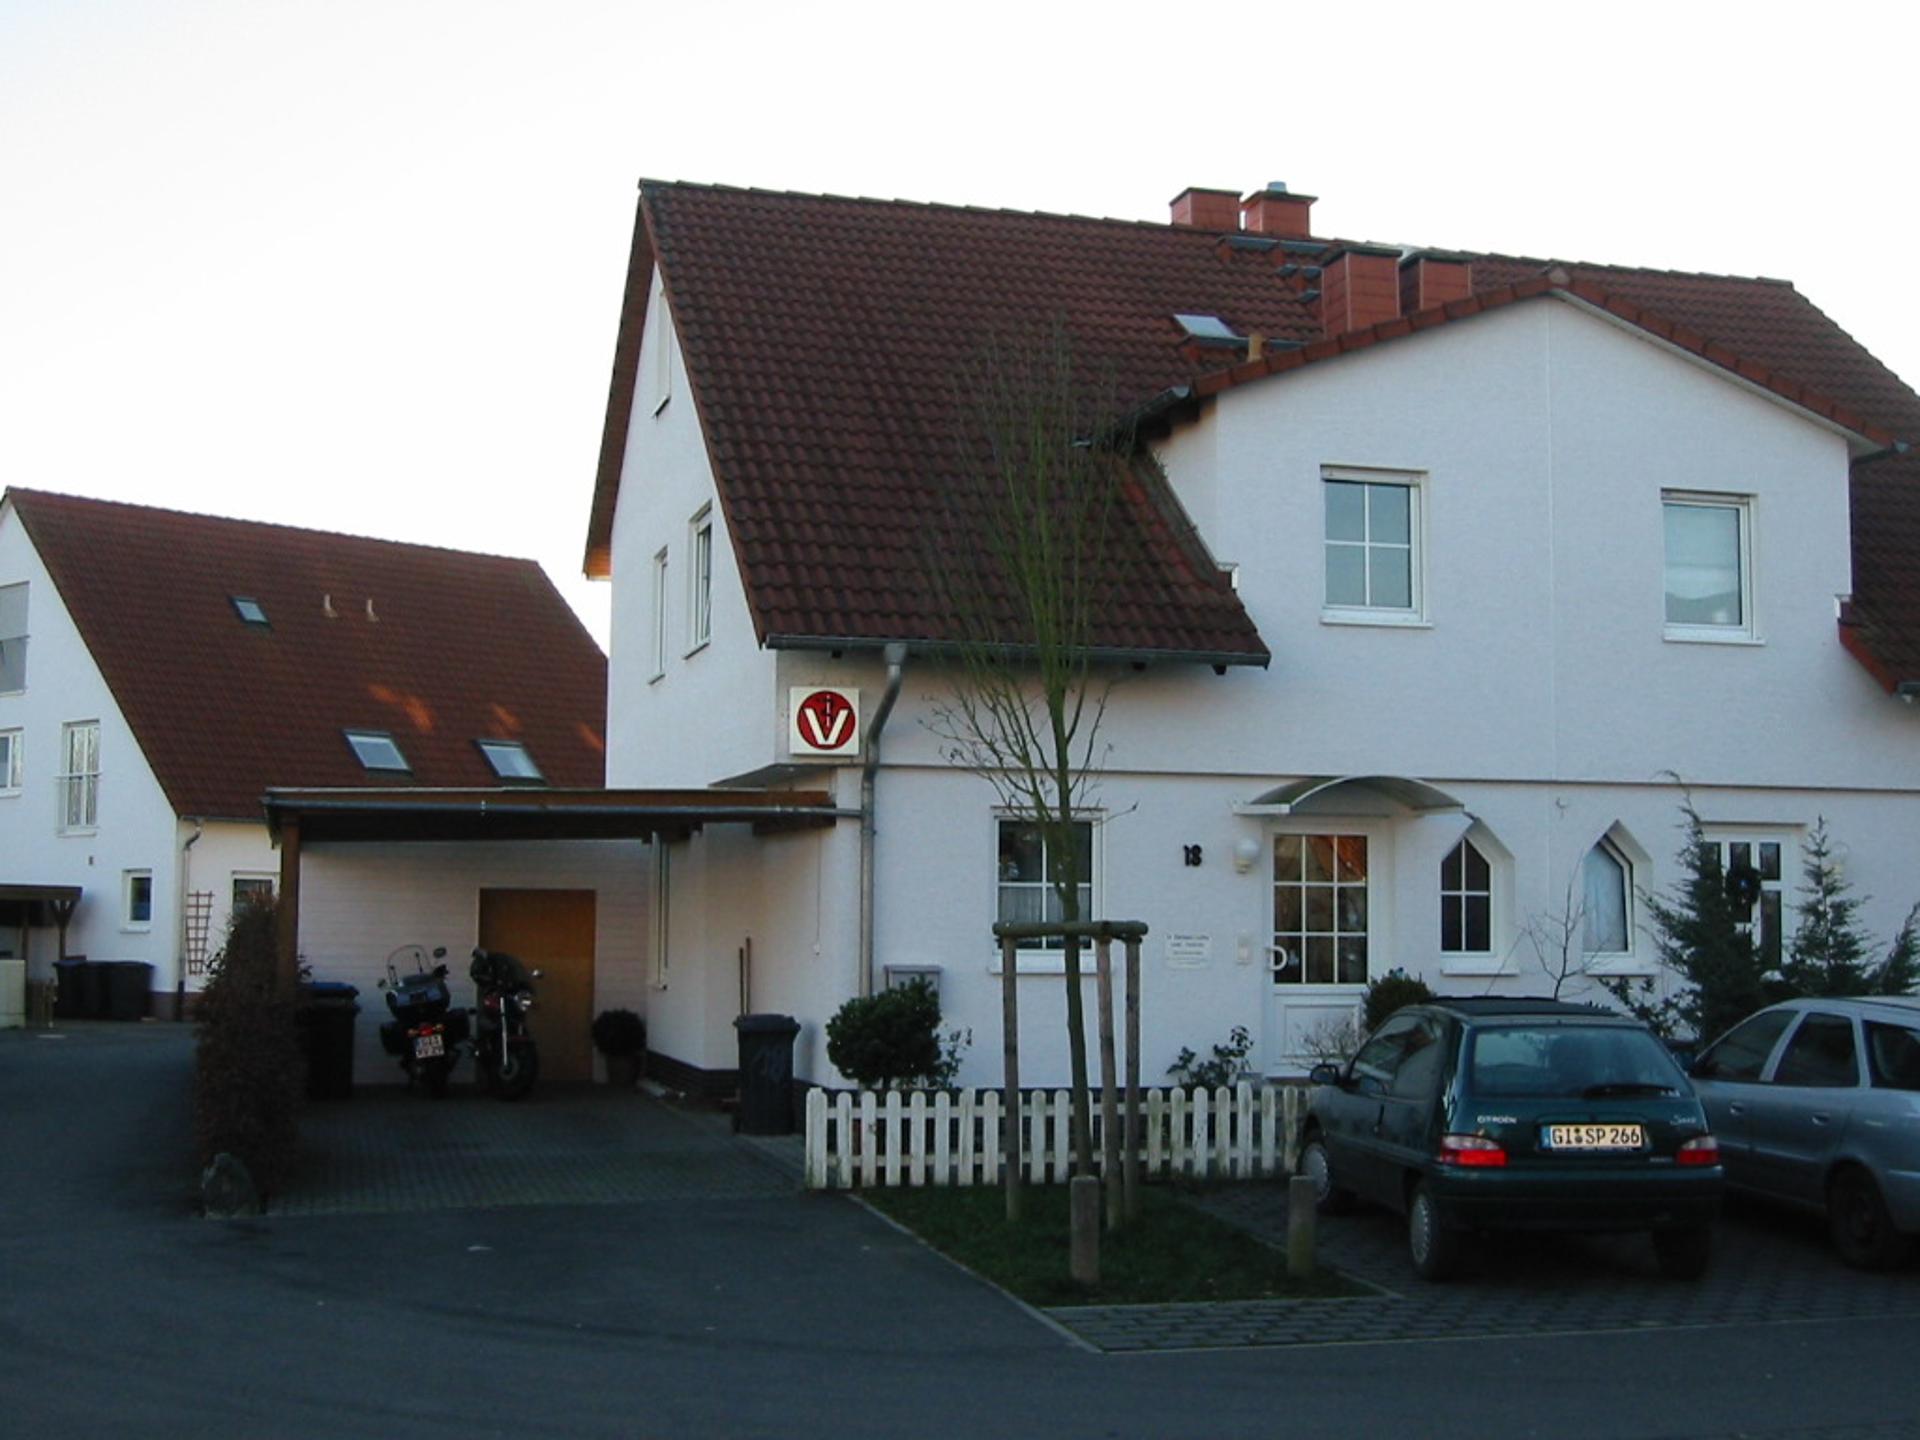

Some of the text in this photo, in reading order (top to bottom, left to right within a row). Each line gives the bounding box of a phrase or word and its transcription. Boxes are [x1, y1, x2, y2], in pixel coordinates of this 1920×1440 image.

[1184, 845, 1202, 866] 18
[1585, 1128, 1606, 1145] SP
[1610, 1128, 1640, 1144] 266
